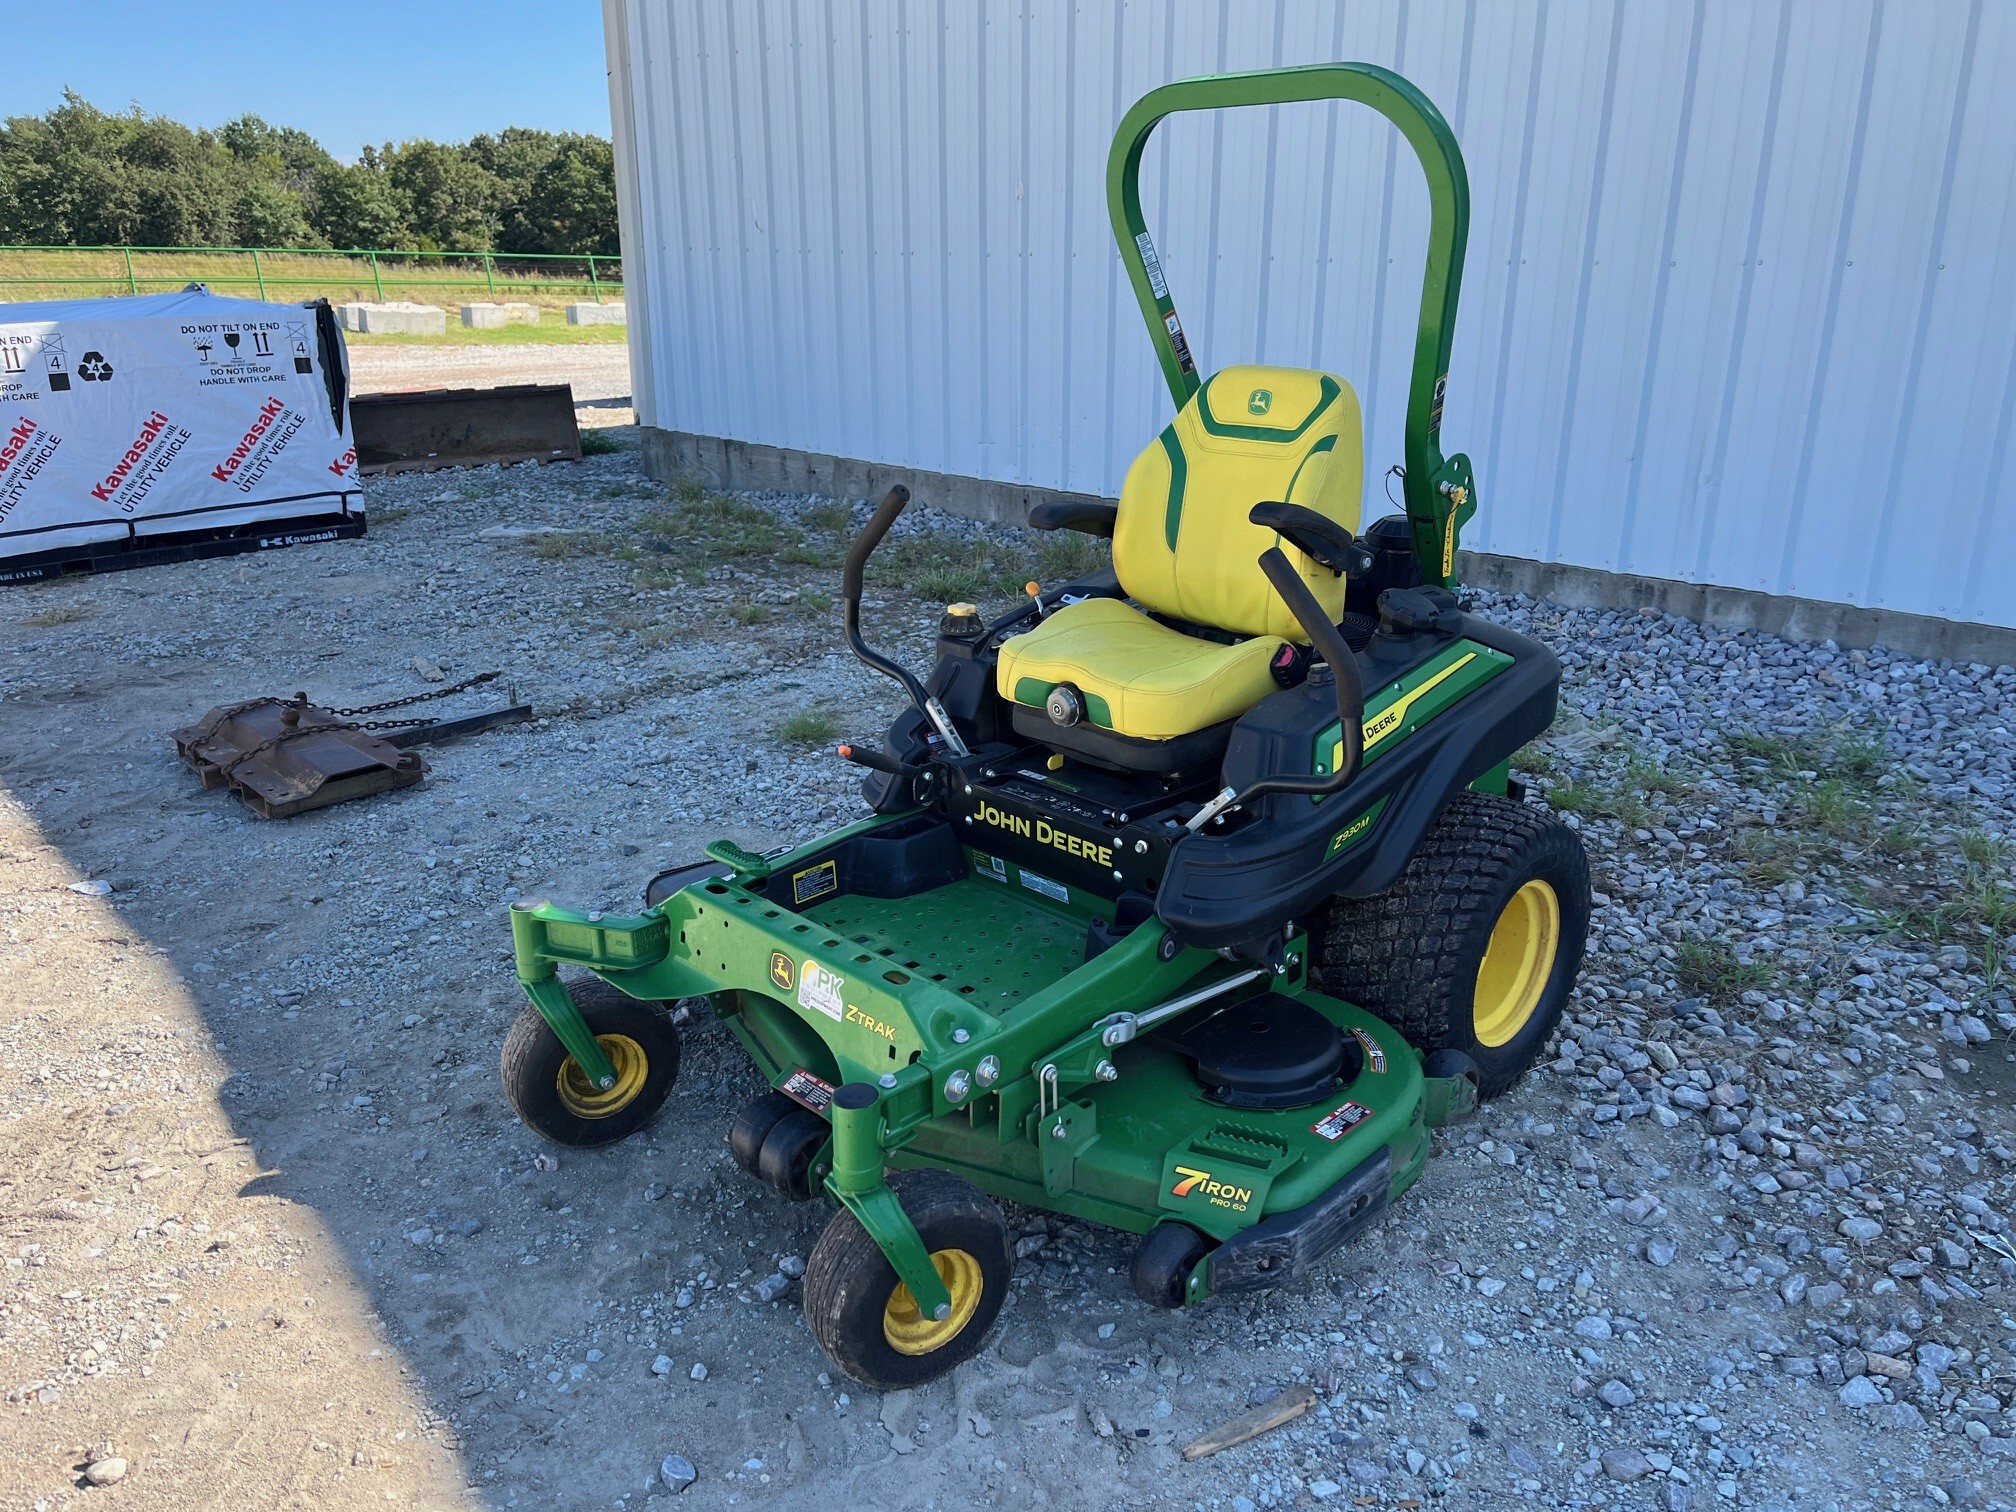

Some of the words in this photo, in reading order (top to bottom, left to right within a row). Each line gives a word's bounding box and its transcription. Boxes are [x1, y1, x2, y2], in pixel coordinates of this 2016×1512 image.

[9, 336, 32, 345] END
[181, 326, 196, 334] DO
[199, 324, 218, 332] NOT
[220, 323, 240, 332] TILT
[243, 323, 257, 331] ON
[260, 322, 280, 330] END
[50, 356, 61, 369] 4
[296, 342, 306, 354] 4
[200, 377, 236, 386] HANDLE
[238, 376, 260, 384] WITH
[262, 374, 287, 382] CARE
[227, 367, 245, 375] NOT
[247, 366, 271, 374] DROP
[0, 384, 22, 392] ROP
[12, 392, 39, 401] CARE
[211, 396, 284, 483] Kawasaki
[232, 472, 247, 486] Let
[244, 460, 255, 472] the
[254, 442, 269, 461] good
[265, 424, 283, 443] times
[239, 455, 273, 493] UTILITY
[268, 413, 306, 455] VEHICLE
[5, 467, 21, 488] good
[17, 447, 37, 468] times
[21, 434, 62, 480] VEHICLE
[91, 410, 169, 502] Kawasaki
[122, 473, 157, 513] UTILITY
[152, 428, 192, 473] VEHICLE
[114, 491, 129, 505] Let
[125, 478, 138, 491] the
[136, 459, 152, 480] good
[149, 440, 167, 460] times
[285, 530, 338, 544] Kawasaki
[1365, 712, 1397, 739] DEERE
[973, 800, 1031, 838] JOHN
[1036, 820, 1113, 868] DEERE
[1333, 815, 1370, 850] Z930M
[845, 1003, 897, 1041] ZTRAK
[1210, 1198, 1230, 1208] PRO
[1233, 1203, 1247, 1212] 60
